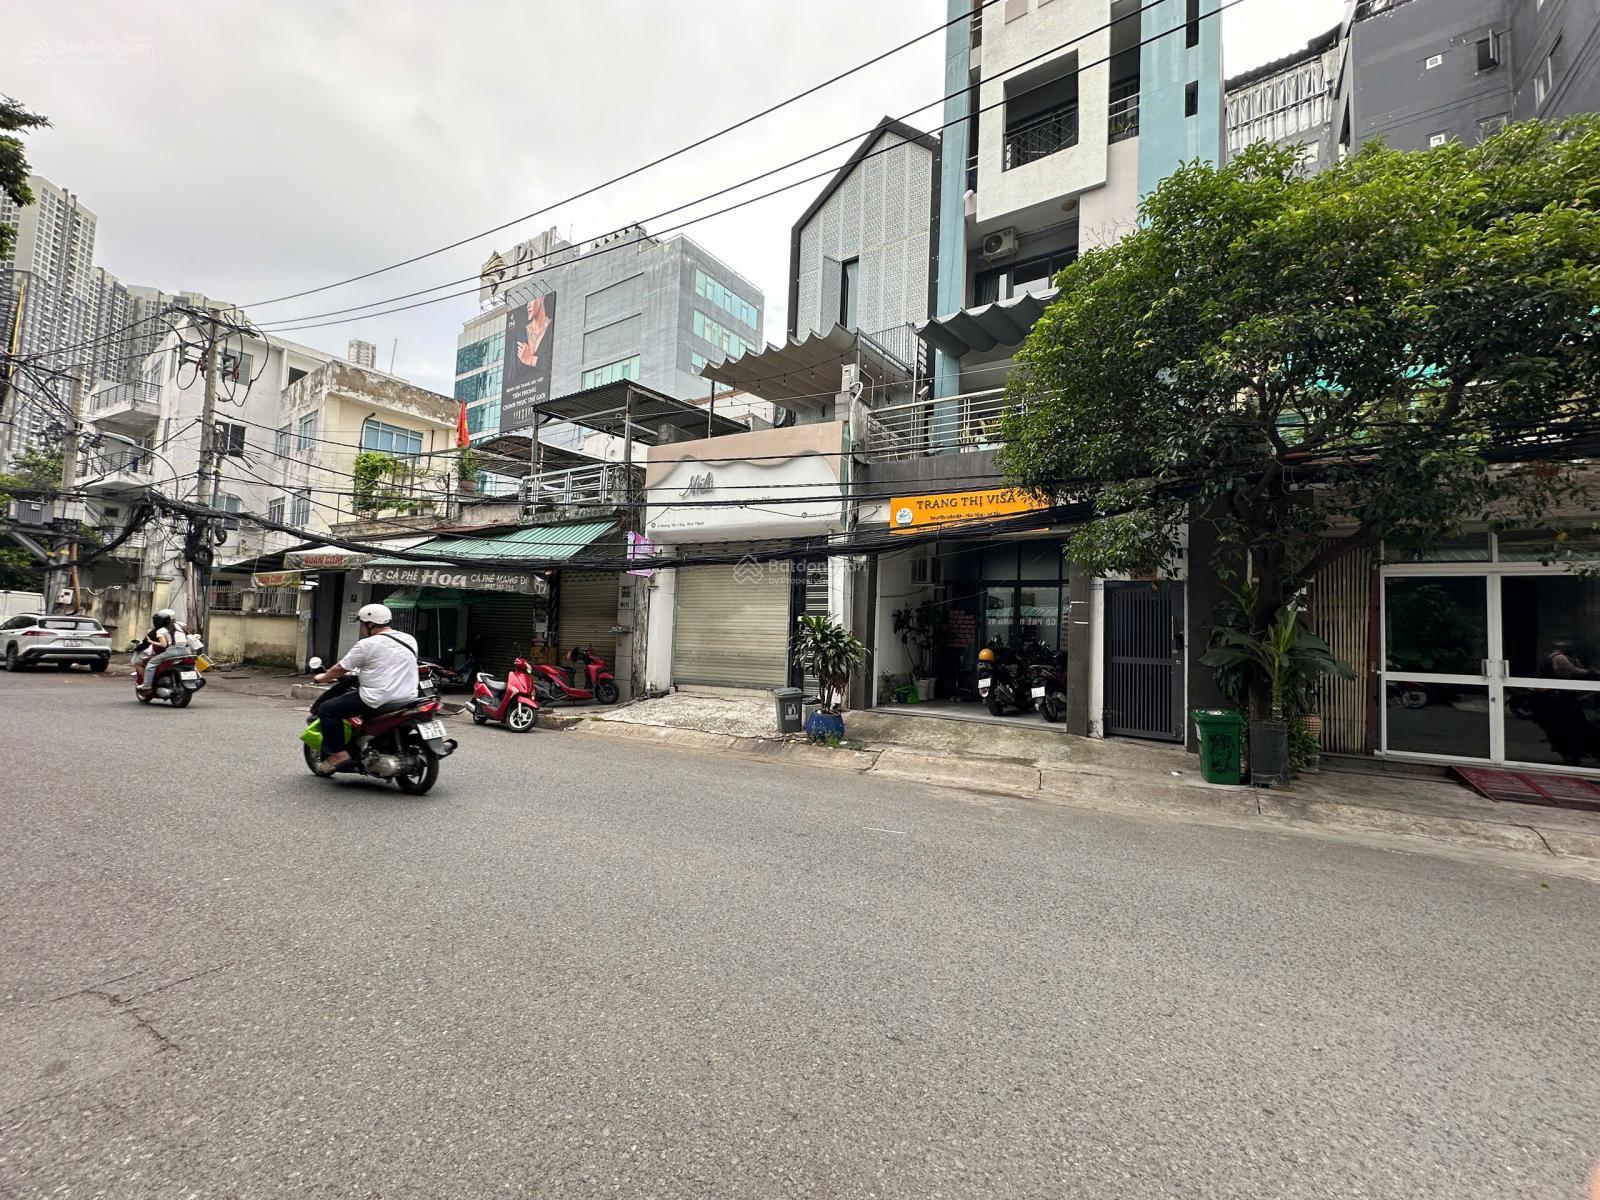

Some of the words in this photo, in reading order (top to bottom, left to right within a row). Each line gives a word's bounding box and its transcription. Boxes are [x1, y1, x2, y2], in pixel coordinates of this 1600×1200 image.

[916, 498, 958, 511] TRANG
[960, 496, 983, 508] THỊ
[986, 491, 1017, 505] VISA
[386, 567, 399, 579] CÀ
[400, 568, 419, 581] PHÊ
[421, 569, 467, 587] Hoa
[470, 571, 481, 583] CÀ
